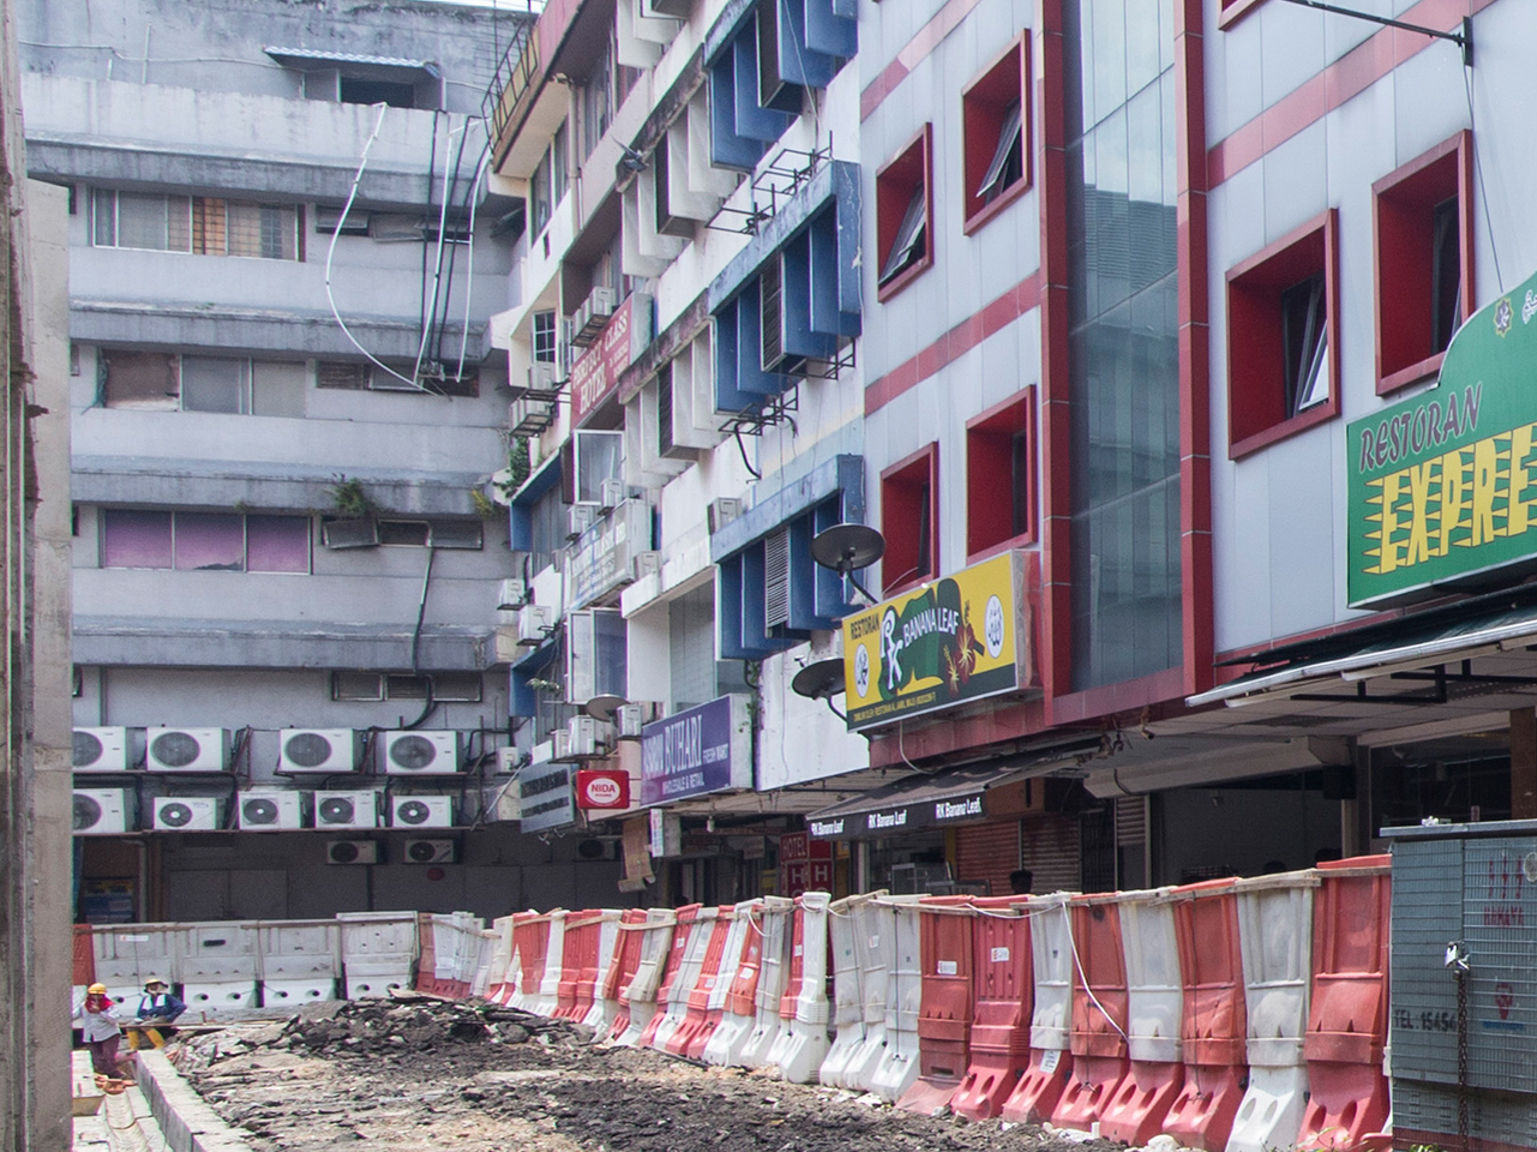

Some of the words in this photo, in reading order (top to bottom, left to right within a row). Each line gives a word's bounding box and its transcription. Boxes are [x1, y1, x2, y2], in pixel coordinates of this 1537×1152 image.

[579, 362, 607, 415] HOTEL
[1358, 383, 1482, 470] RESTORAN
[850, 612, 880, 640] RESTORAN
[903, 608, 937, 648] BANANA
[938, 607, 960, 636] LEAF
[664, 714, 703, 776] BUHARI
[590, 783, 617, 793] NIDA
[782, 834, 807, 862] HOTEL
